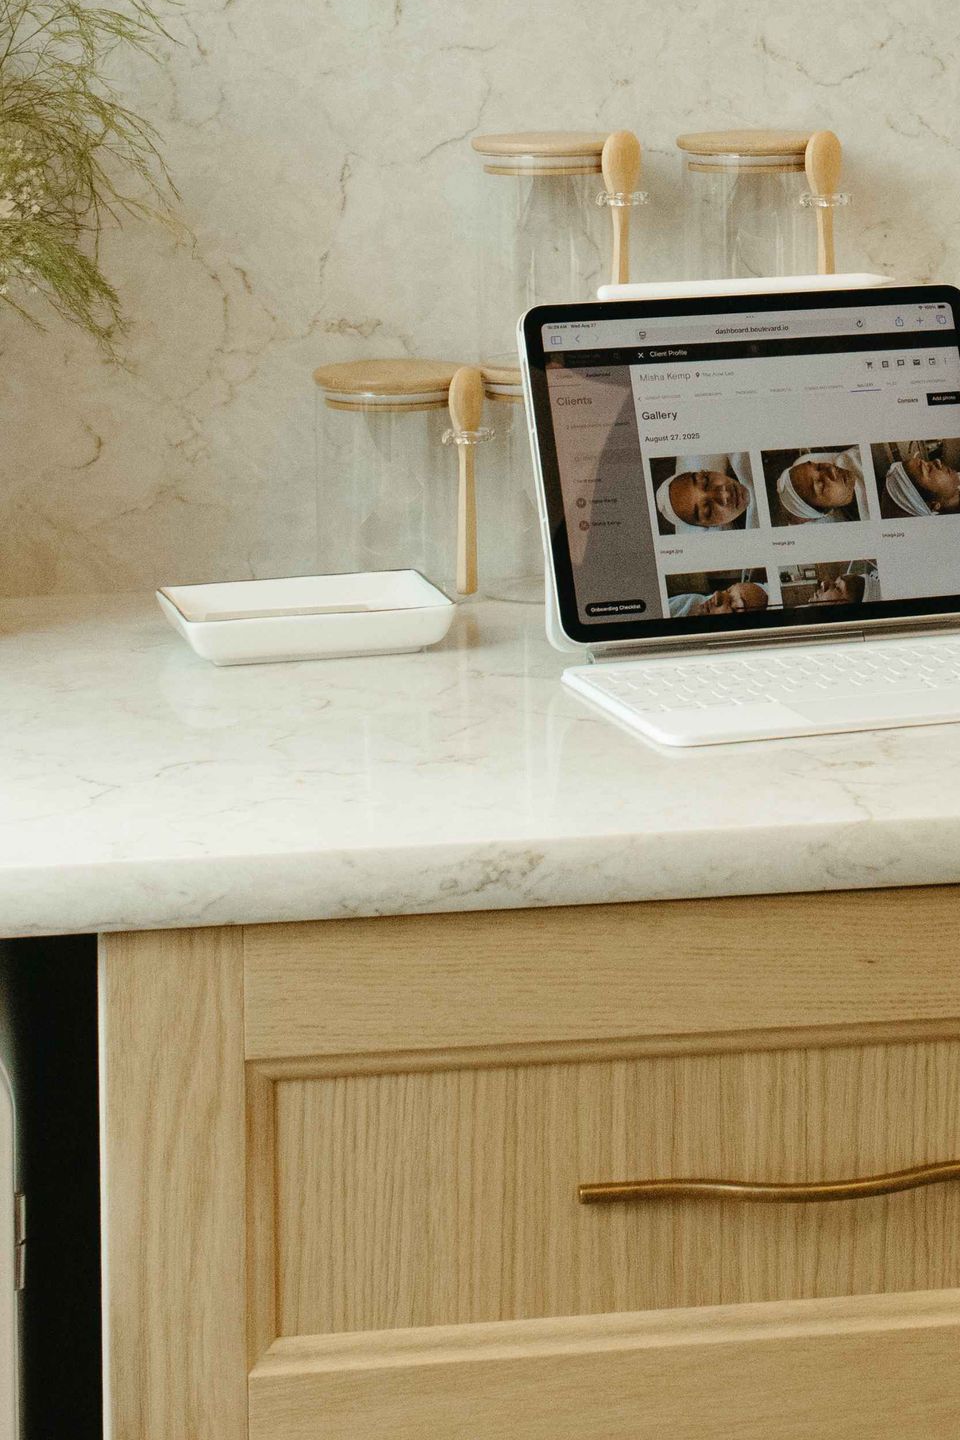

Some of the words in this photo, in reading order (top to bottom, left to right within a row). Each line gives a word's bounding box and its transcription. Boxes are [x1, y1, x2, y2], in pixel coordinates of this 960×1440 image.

[715, 324, 789, 335] dashboard.boulevard.io
[649, 350, 667, 358] Client
[668, 349, 688, 357] Profile
[639, 373, 665, 382] Misha
[666, 371, 691, 382] Kemp
[556, 396, 593, 407] Clients
[641, 411, 678, 422] Gallery
[644, 433, 669, 444] August
[683, 432, 700, 441] 2025
